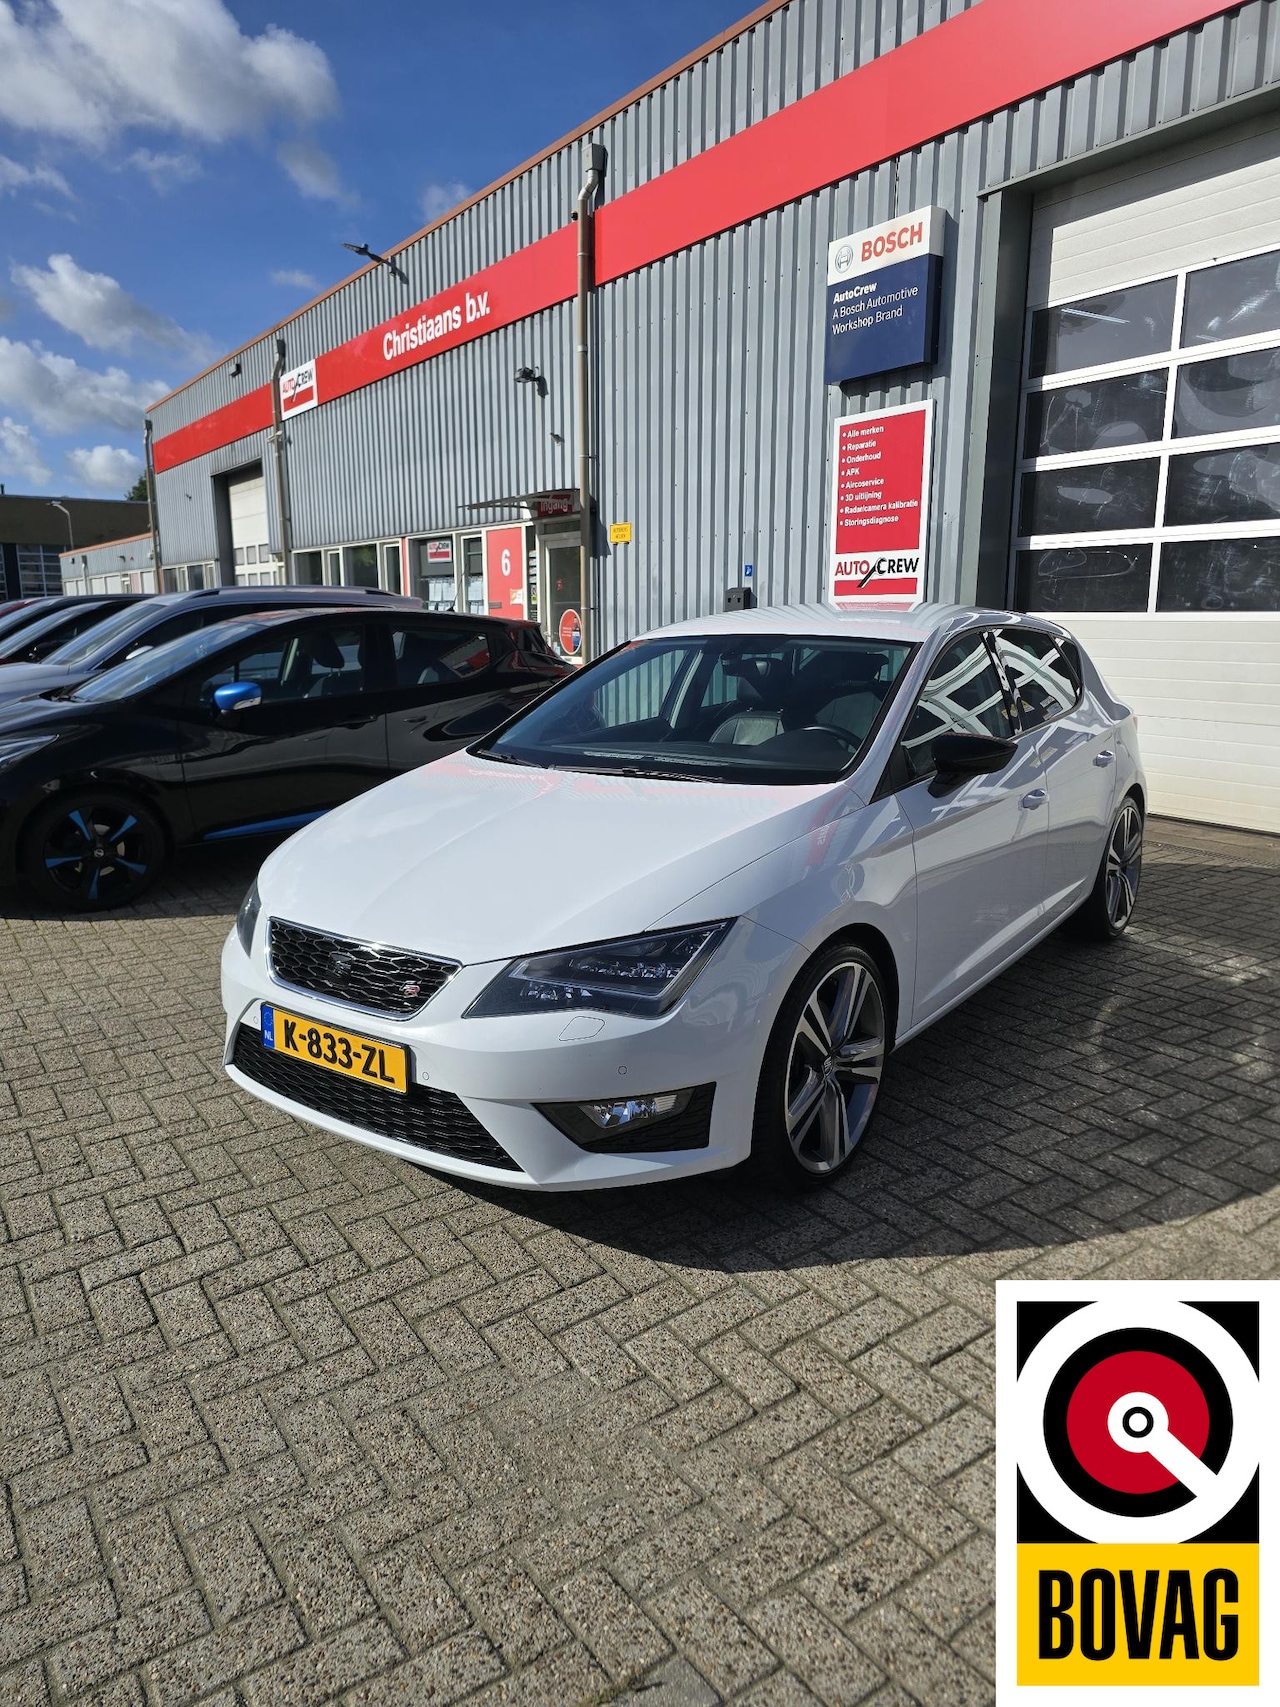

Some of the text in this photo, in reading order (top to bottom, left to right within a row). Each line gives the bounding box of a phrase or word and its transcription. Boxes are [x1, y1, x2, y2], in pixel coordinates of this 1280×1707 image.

[861, 222, 923, 262] BOSCH
[833, 282, 877, 304] AutoCrew
[832, 286, 919, 320] A Bosch Automotive
[383, 291, 490, 361] Christiaans b.v.
[832, 305, 903, 335] Workshop Brand
[847, 426, 884, 438] Alle merken
[847, 440, 877, 452] Reparatie
[846, 451, 882, 464] Onderhoud
[845, 467, 860, 477] APK
[845, 478, 884, 489] Aircoservice
[845, 493, 854, 502] 3D
[888, 499, 918, 510] kalibratie
[844, 515, 899, 527] Storingsdiagnose
[501, 548, 511, 577] 6
[835, 557, 920, 576] AUTO CREW
[264, 1029, 274, 1041] NL
[283, 1018, 396, 1084] K-833-ZL
